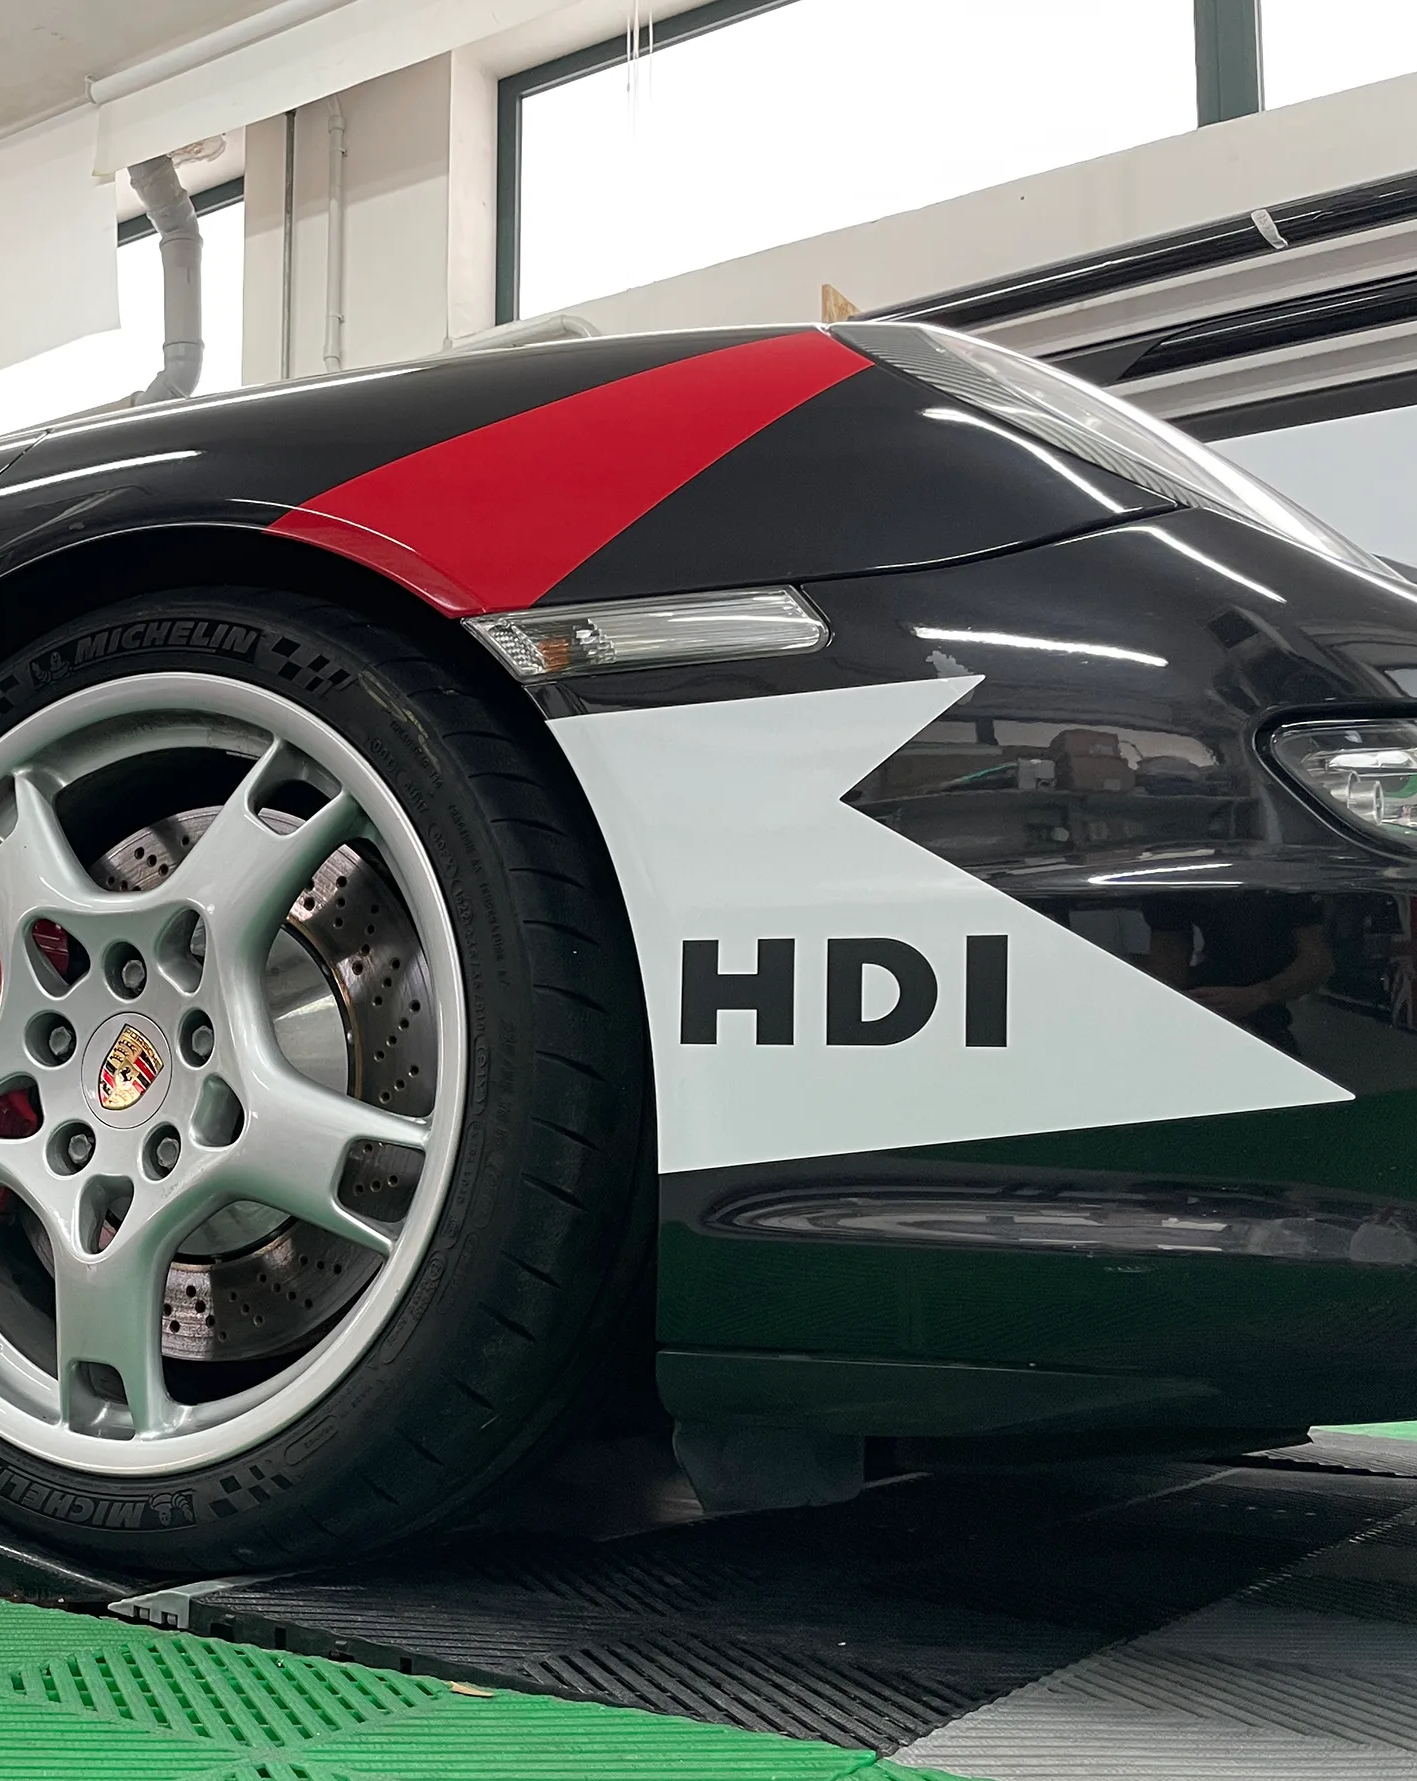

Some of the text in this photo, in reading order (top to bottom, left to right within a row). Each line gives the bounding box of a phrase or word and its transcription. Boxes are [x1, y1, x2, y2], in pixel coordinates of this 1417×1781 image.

[74, 621, 258, 665] MICHELIN
[680, 934, 1009, 1048] HDI
[123, 1027, 162, 1066] PORSCHE
